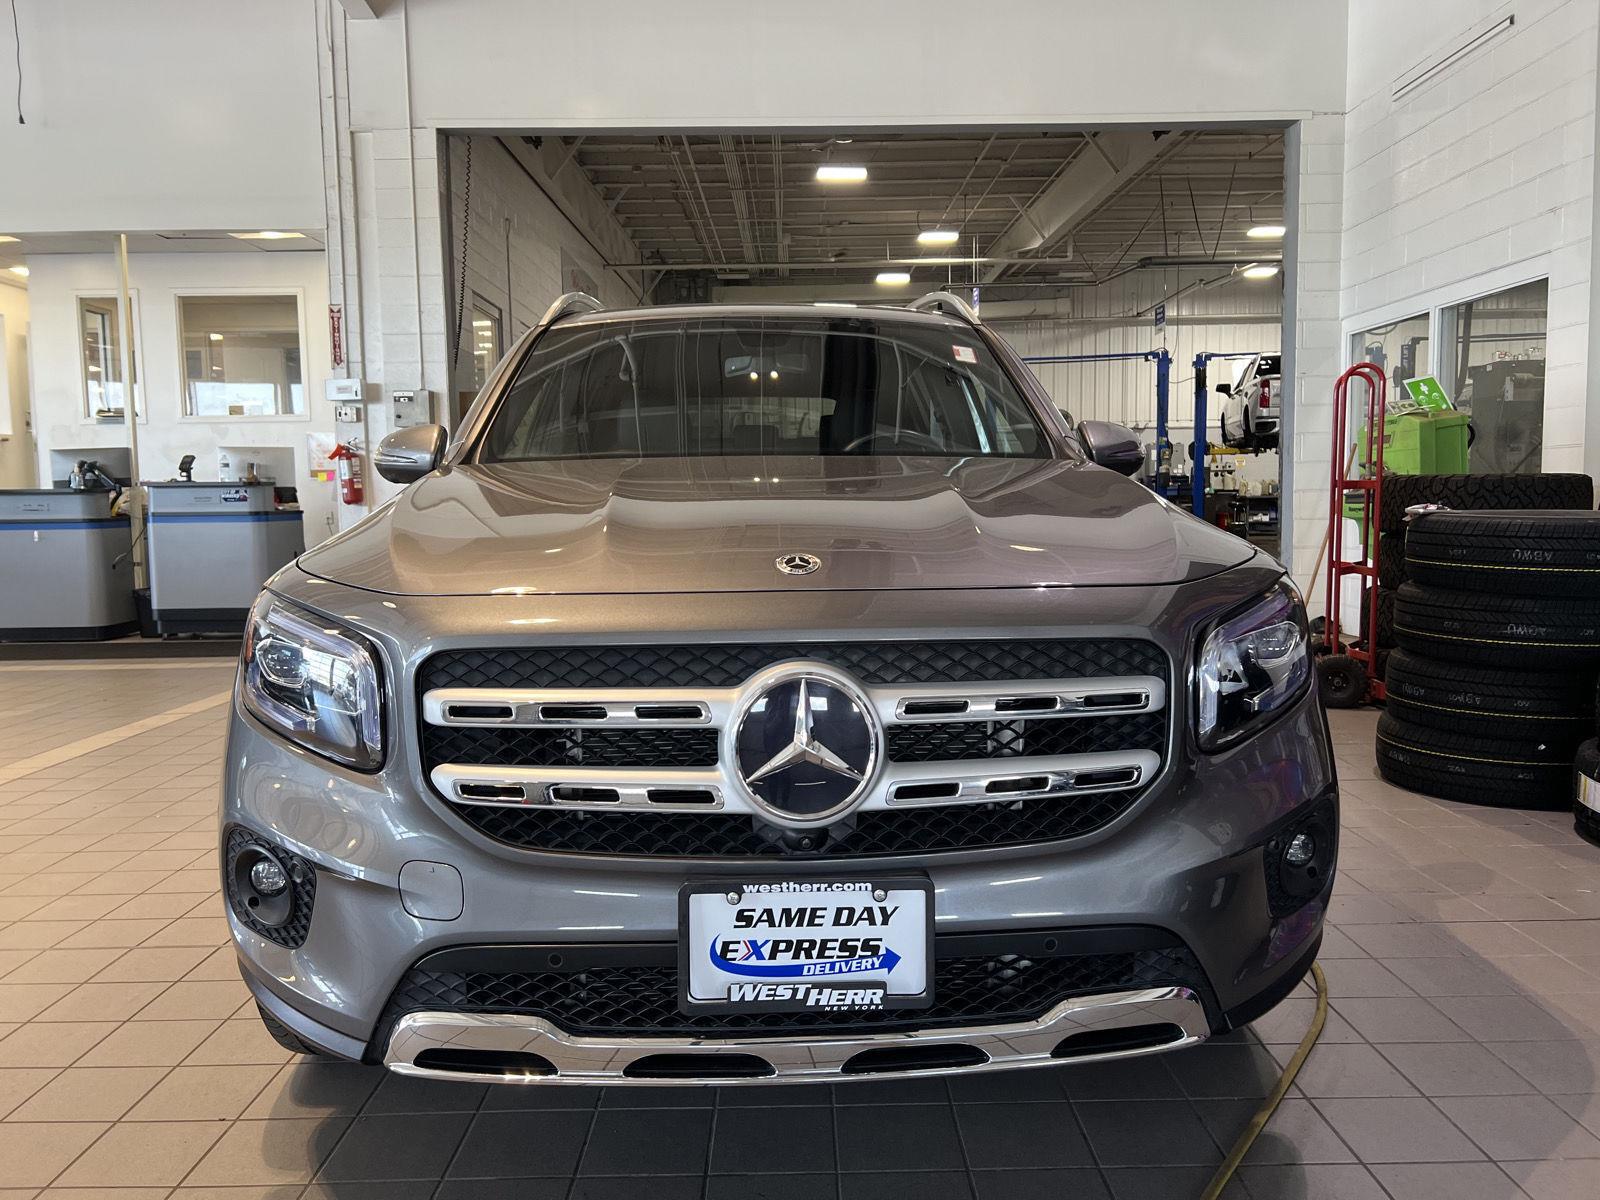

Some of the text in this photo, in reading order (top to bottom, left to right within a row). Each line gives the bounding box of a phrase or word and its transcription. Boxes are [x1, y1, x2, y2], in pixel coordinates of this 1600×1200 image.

[743, 881, 872, 893] westherr.com
[734, 905, 900, 928] SAME DAY
[719, 938, 883, 961] EXPRESS
[802, 956, 884, 976] DELIVERY
